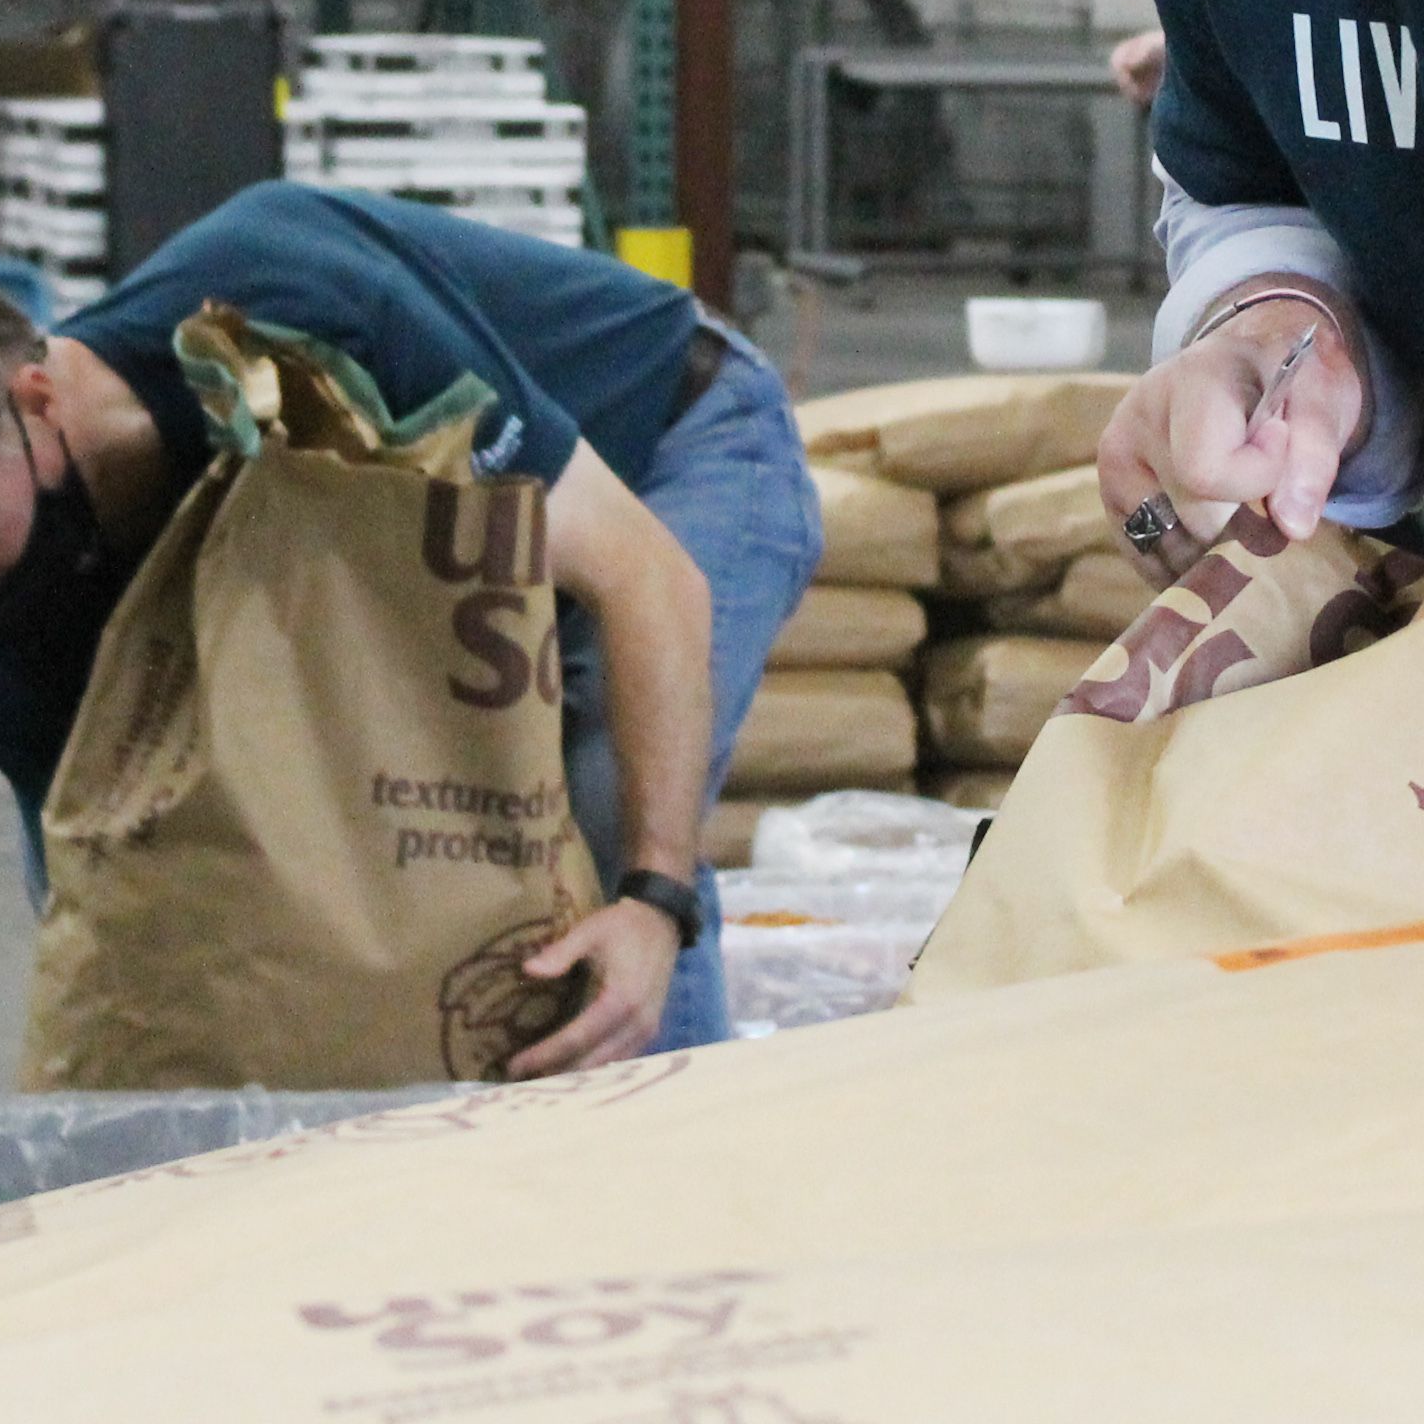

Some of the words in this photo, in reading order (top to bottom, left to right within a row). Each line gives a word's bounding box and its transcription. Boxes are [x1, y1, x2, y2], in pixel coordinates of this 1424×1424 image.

[1293, 13, 1417, 149] LIV
[371, 772, 547, 821] textured
[395, 827, 545, 869] protein
